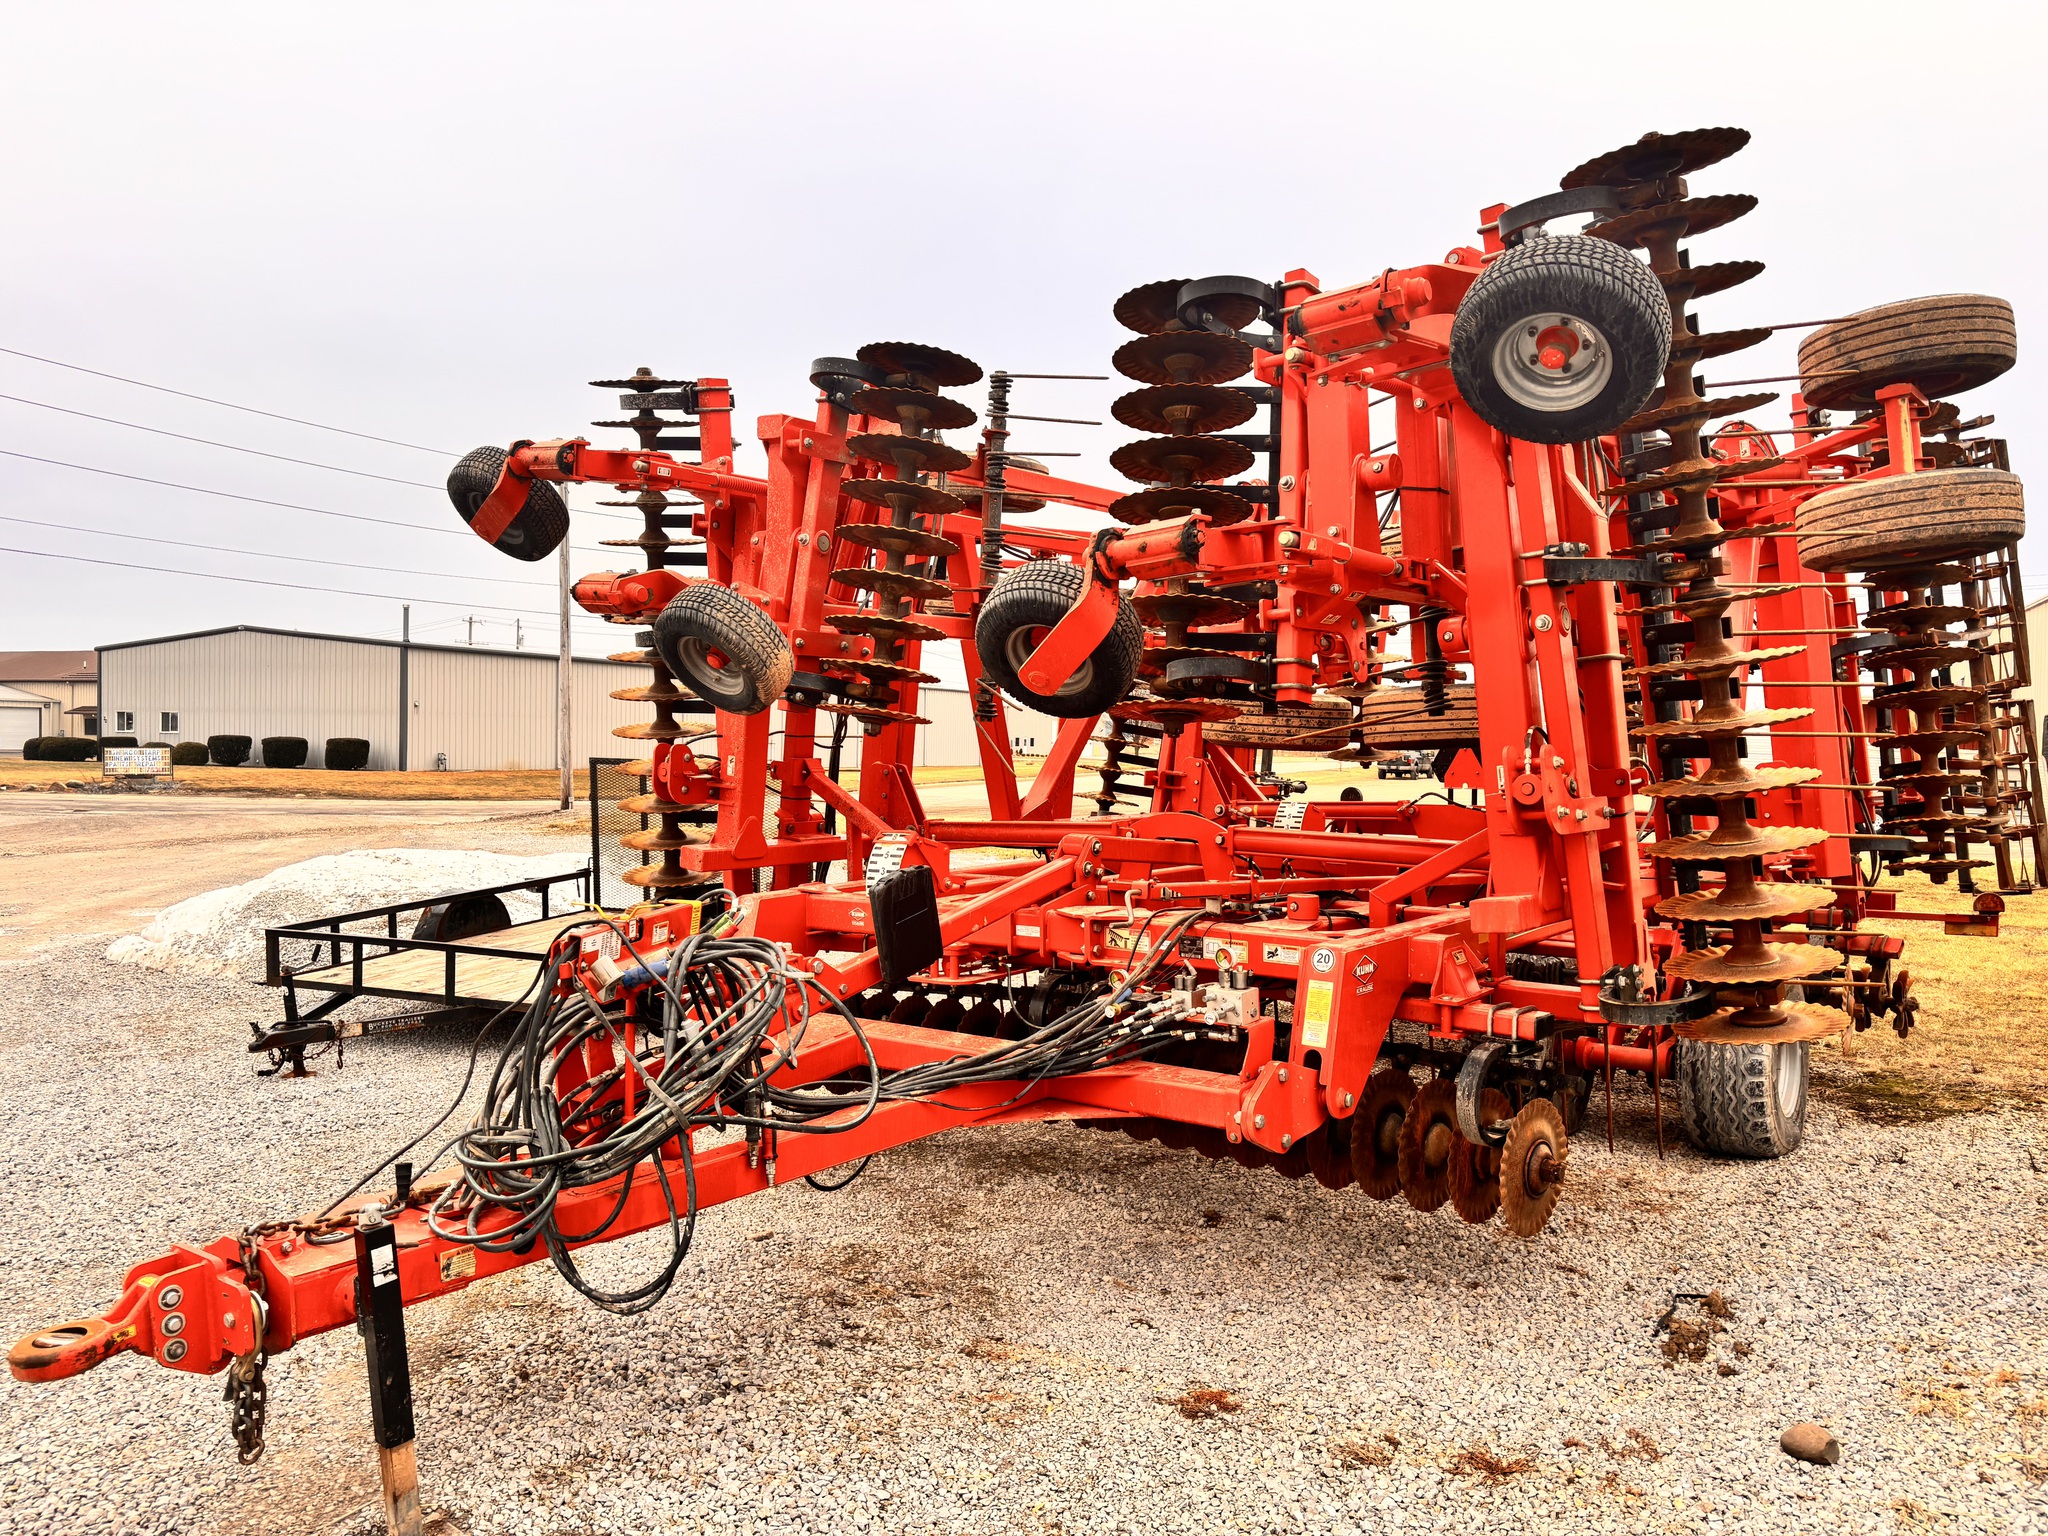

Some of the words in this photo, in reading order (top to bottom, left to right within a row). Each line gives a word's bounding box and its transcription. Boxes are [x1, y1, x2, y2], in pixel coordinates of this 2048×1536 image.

[880, 867, 886, 876] 3
[1316, 953, 1331, 965] 20
[1356, 963, 1374, 977] KUHN
[369, 1020, 396, 1030] BUCKEYE
